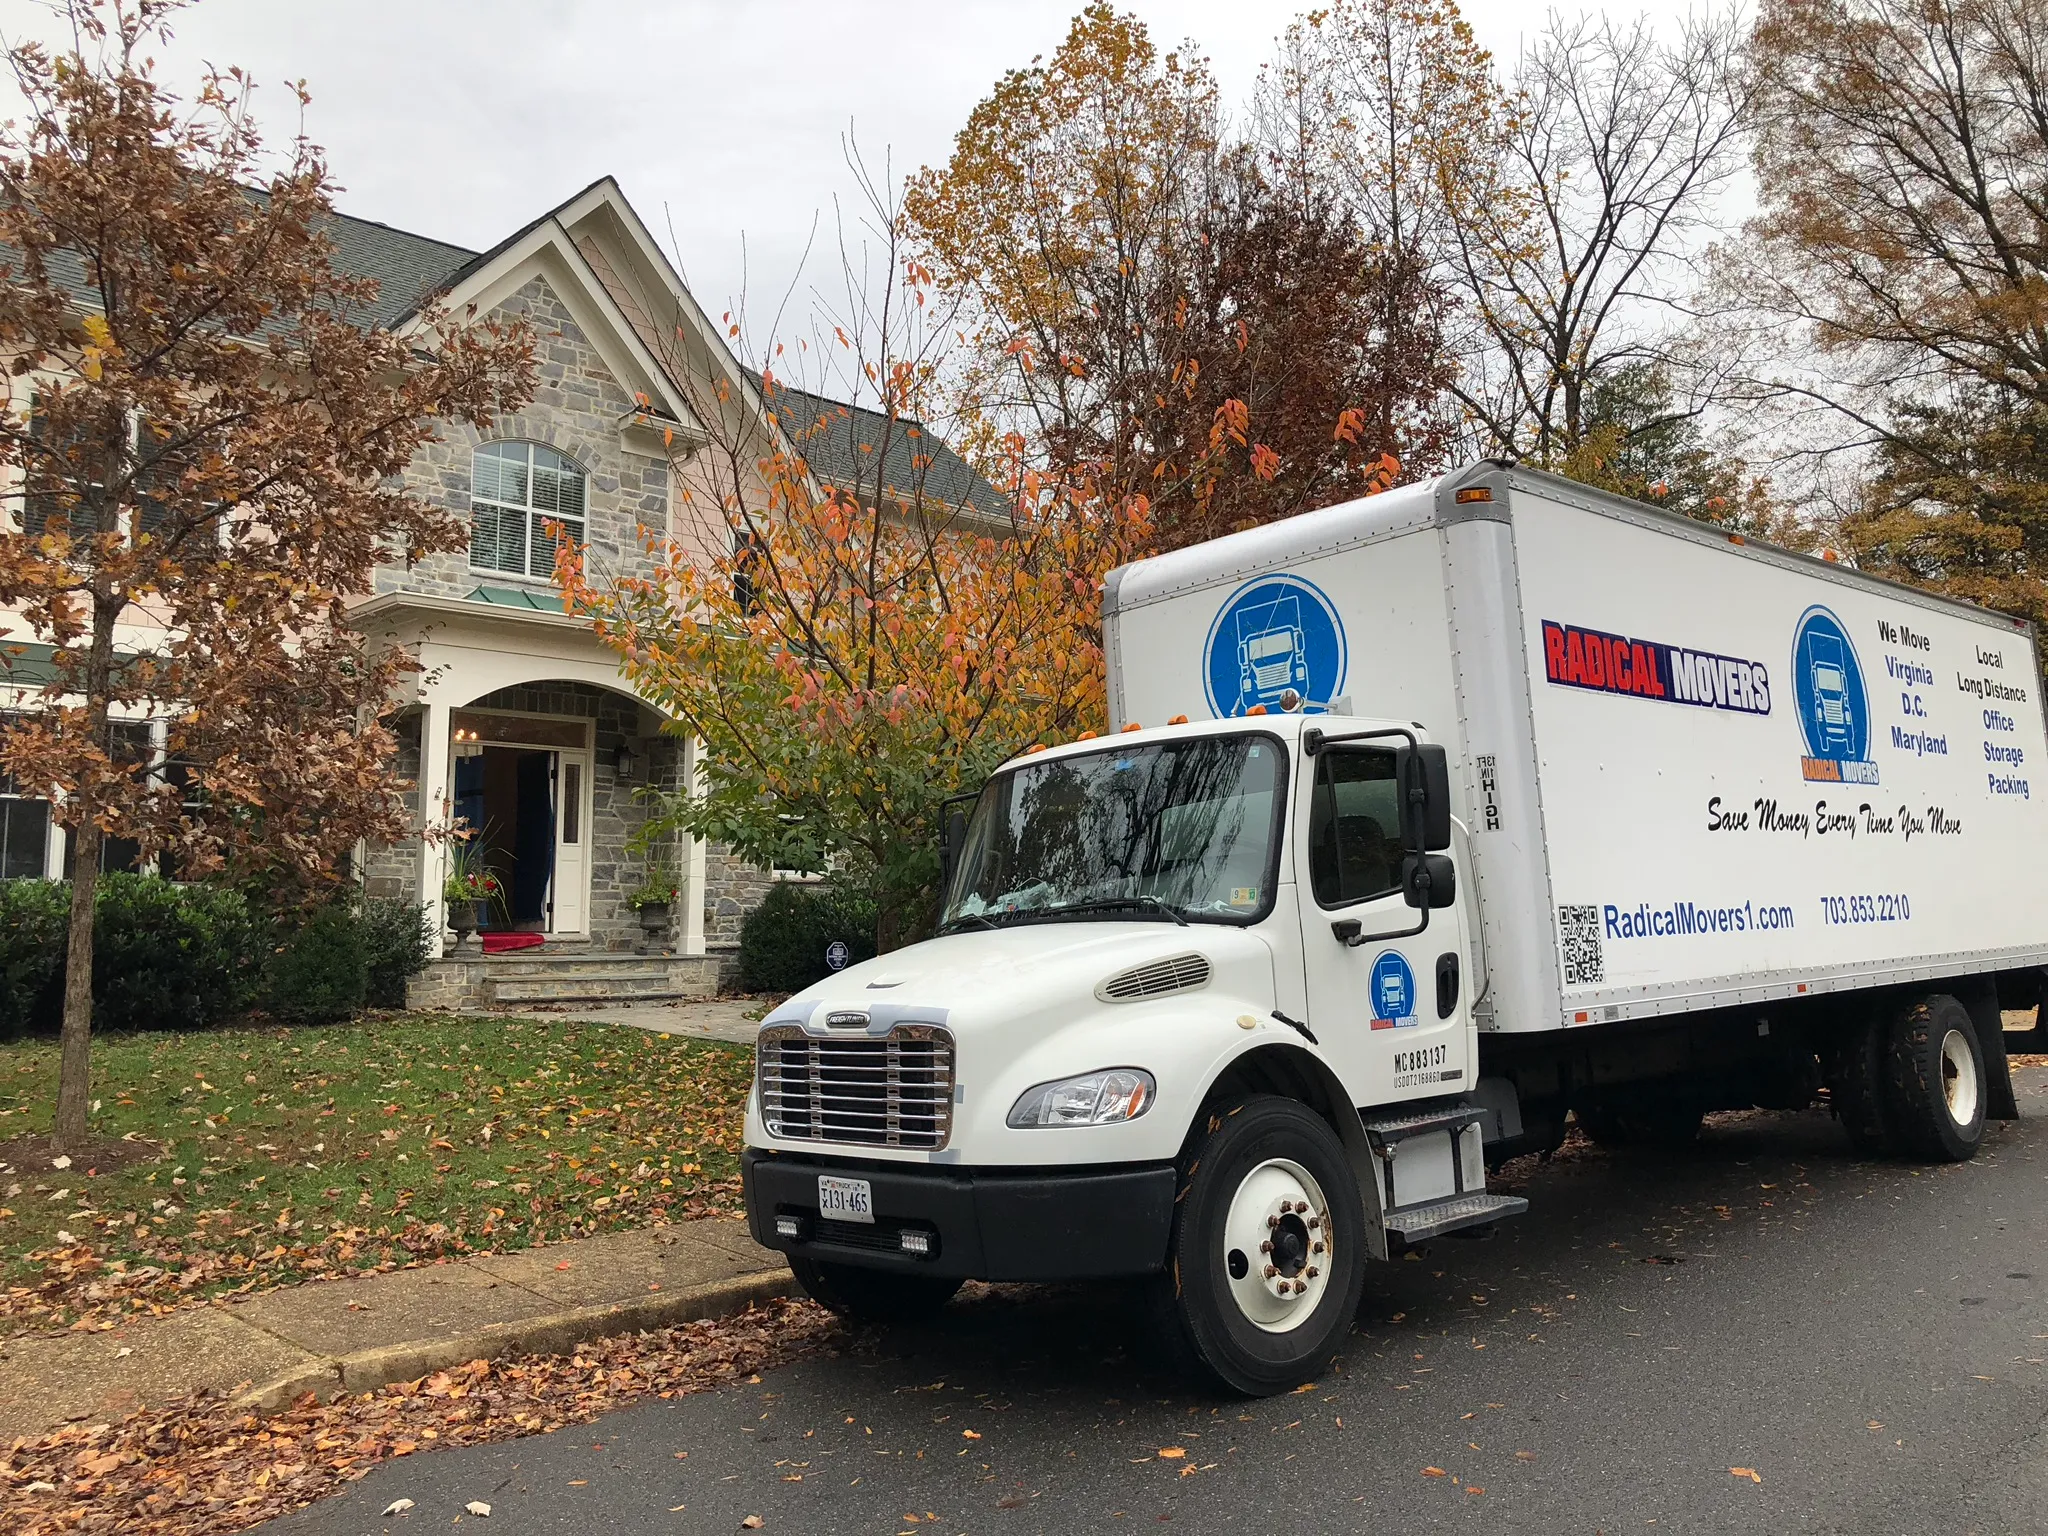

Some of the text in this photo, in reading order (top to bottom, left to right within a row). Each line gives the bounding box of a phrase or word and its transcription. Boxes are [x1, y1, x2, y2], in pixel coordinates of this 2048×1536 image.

[1877, 620, 1931, 651] We Move
[1544, 624, 1770, 711] RADICAL MOVERS
[1884, 655, 1934, 687] Virginia
[1975, 645, 2003, 669] Local
[1956, 671, 2027, 703] Long Distance
[1901, 693, 1928, 718] D.C.
[1982, 709, 2014, 732] Office
[1891, 725, 1948, 757] Maryland
[1983, 741, 2024, 767] Storage
[1802, 757, 1879, 783] RADICAL MOVERS
[1988, 773, 2030, 800] Packing
[1708, 796, 1962, 842] Save Money Every Time You Move
[1604, 893, 1911, 940] RadicalMovers1.com 703.853.2210
[1394, 1044, 1447, 1074] MC883137
